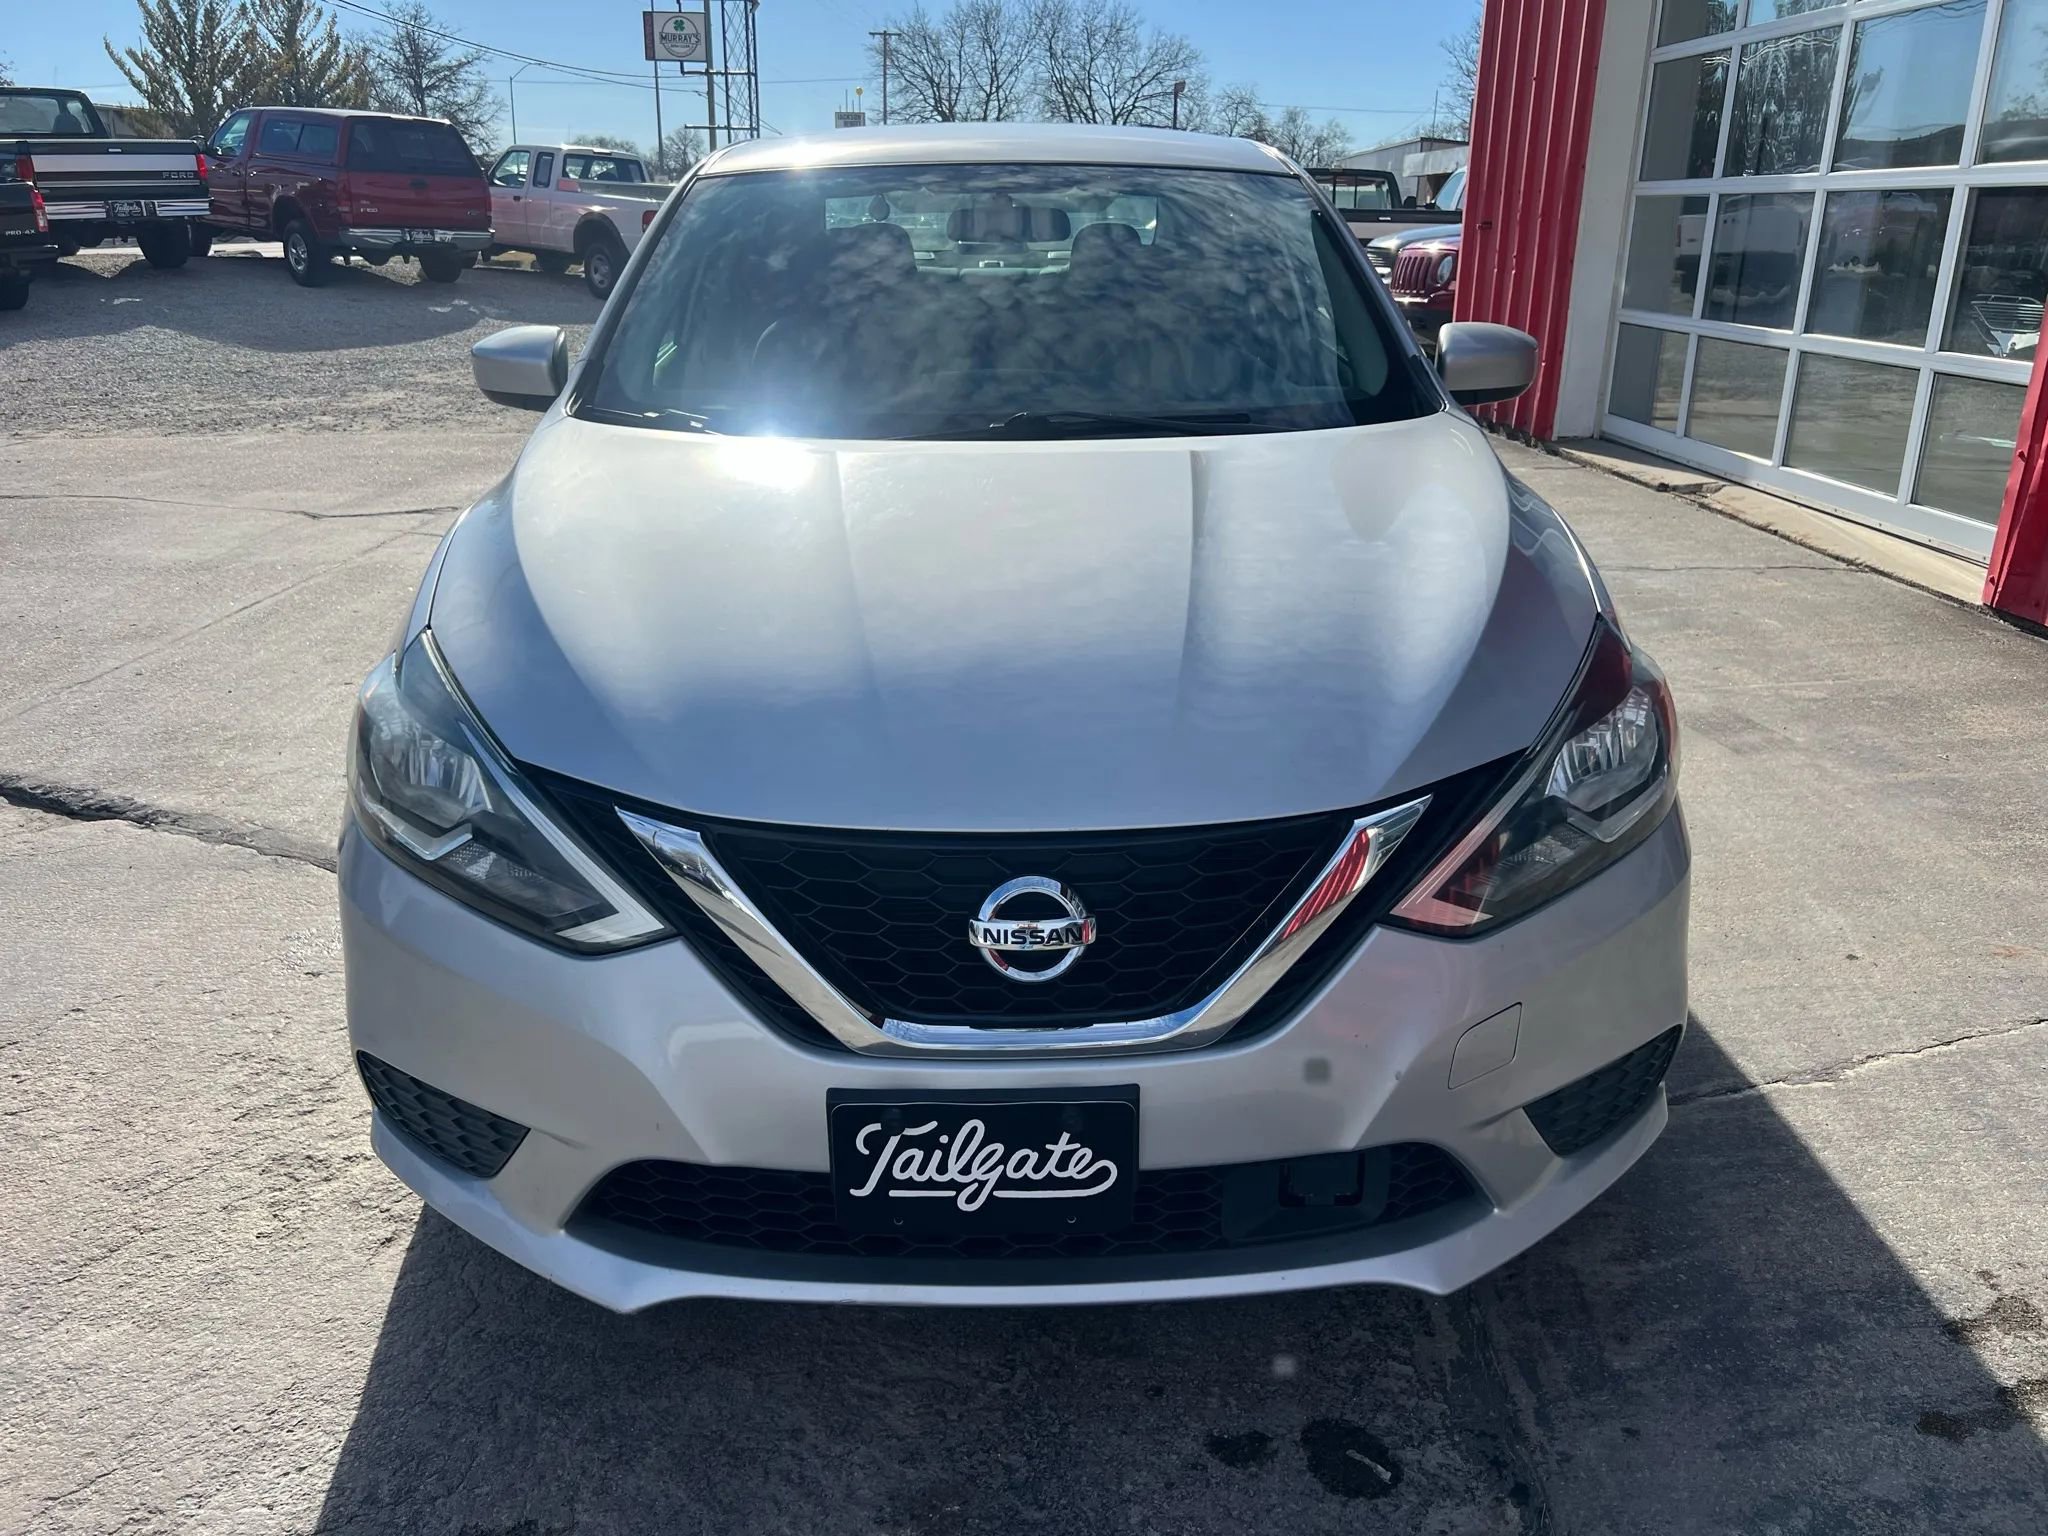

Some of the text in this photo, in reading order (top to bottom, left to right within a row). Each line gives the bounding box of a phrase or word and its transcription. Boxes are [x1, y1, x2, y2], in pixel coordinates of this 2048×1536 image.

[660, 34, 701, 44] MURRAY'S
[162, 171, 194, 179] FORD
[982, 927, 1082, 946] NISSAN
[850, 1119, 1118, 1211] Tailgate
